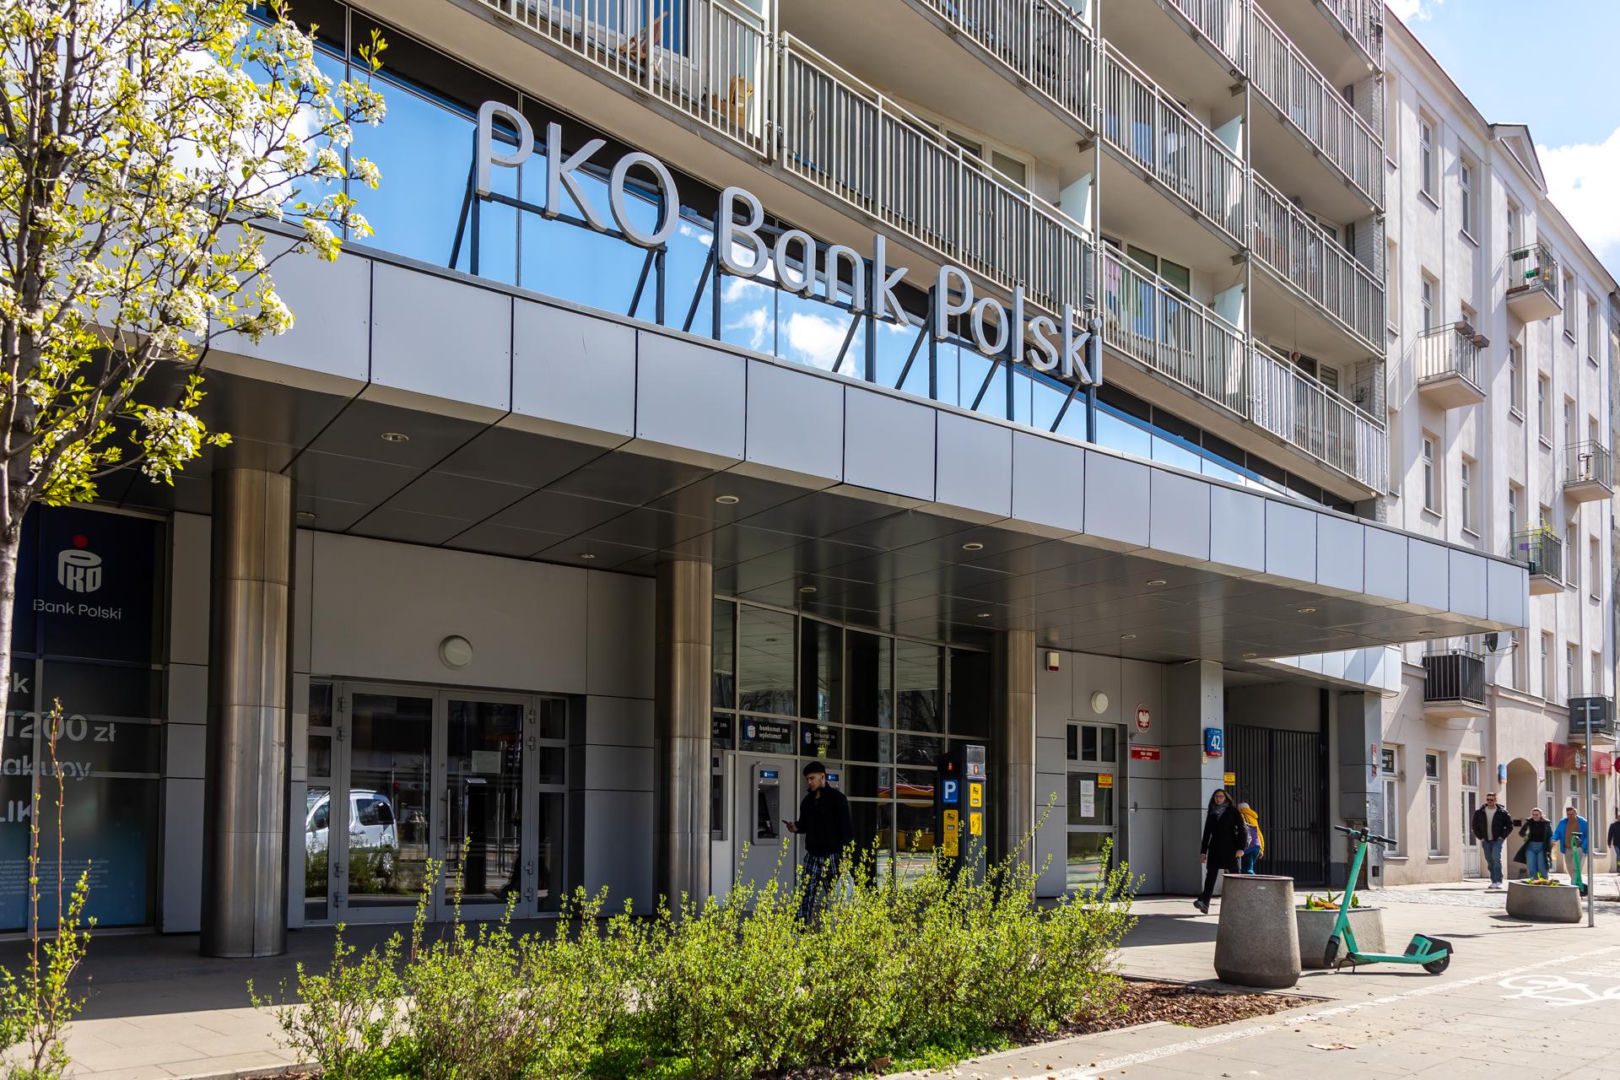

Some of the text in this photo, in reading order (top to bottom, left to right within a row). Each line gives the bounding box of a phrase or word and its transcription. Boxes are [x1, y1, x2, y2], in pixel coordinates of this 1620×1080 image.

[476, 100, 1103, 387] PKO Bank Polski
[33, 598, 122, 620] Bank Polski
[6, 711, 118, 742] 1200 zł
[1211, 735, 1221, 750] 42
[945, 782, 956, 799] P
